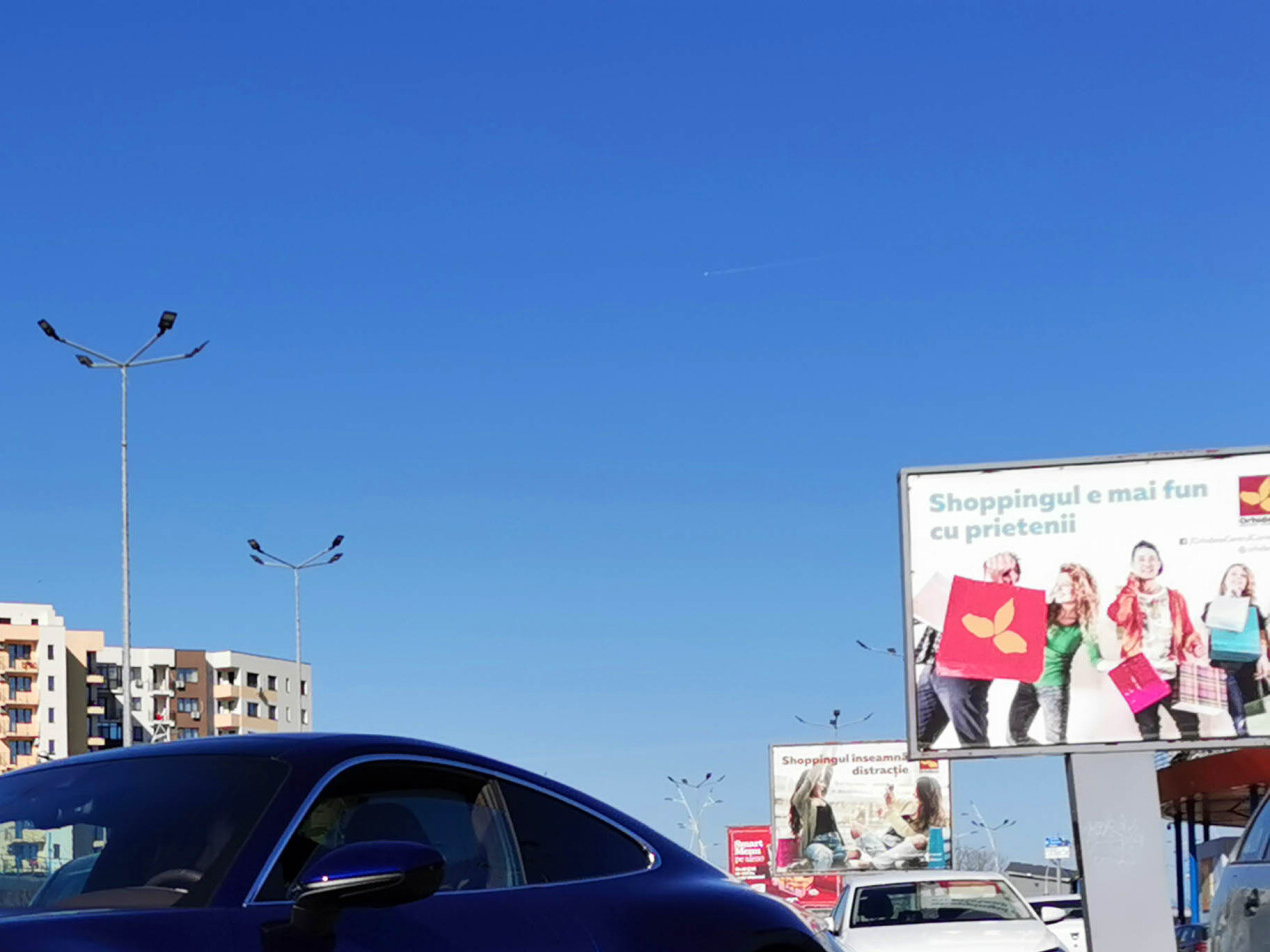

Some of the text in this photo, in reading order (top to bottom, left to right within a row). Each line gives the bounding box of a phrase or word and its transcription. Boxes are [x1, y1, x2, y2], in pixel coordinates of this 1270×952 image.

[929, 479, 1208, 515] Shoppingul e mai fun
[930, 513, 1077, 545] cu prietenii
[781, 754, 849, 767] Shoppingul
